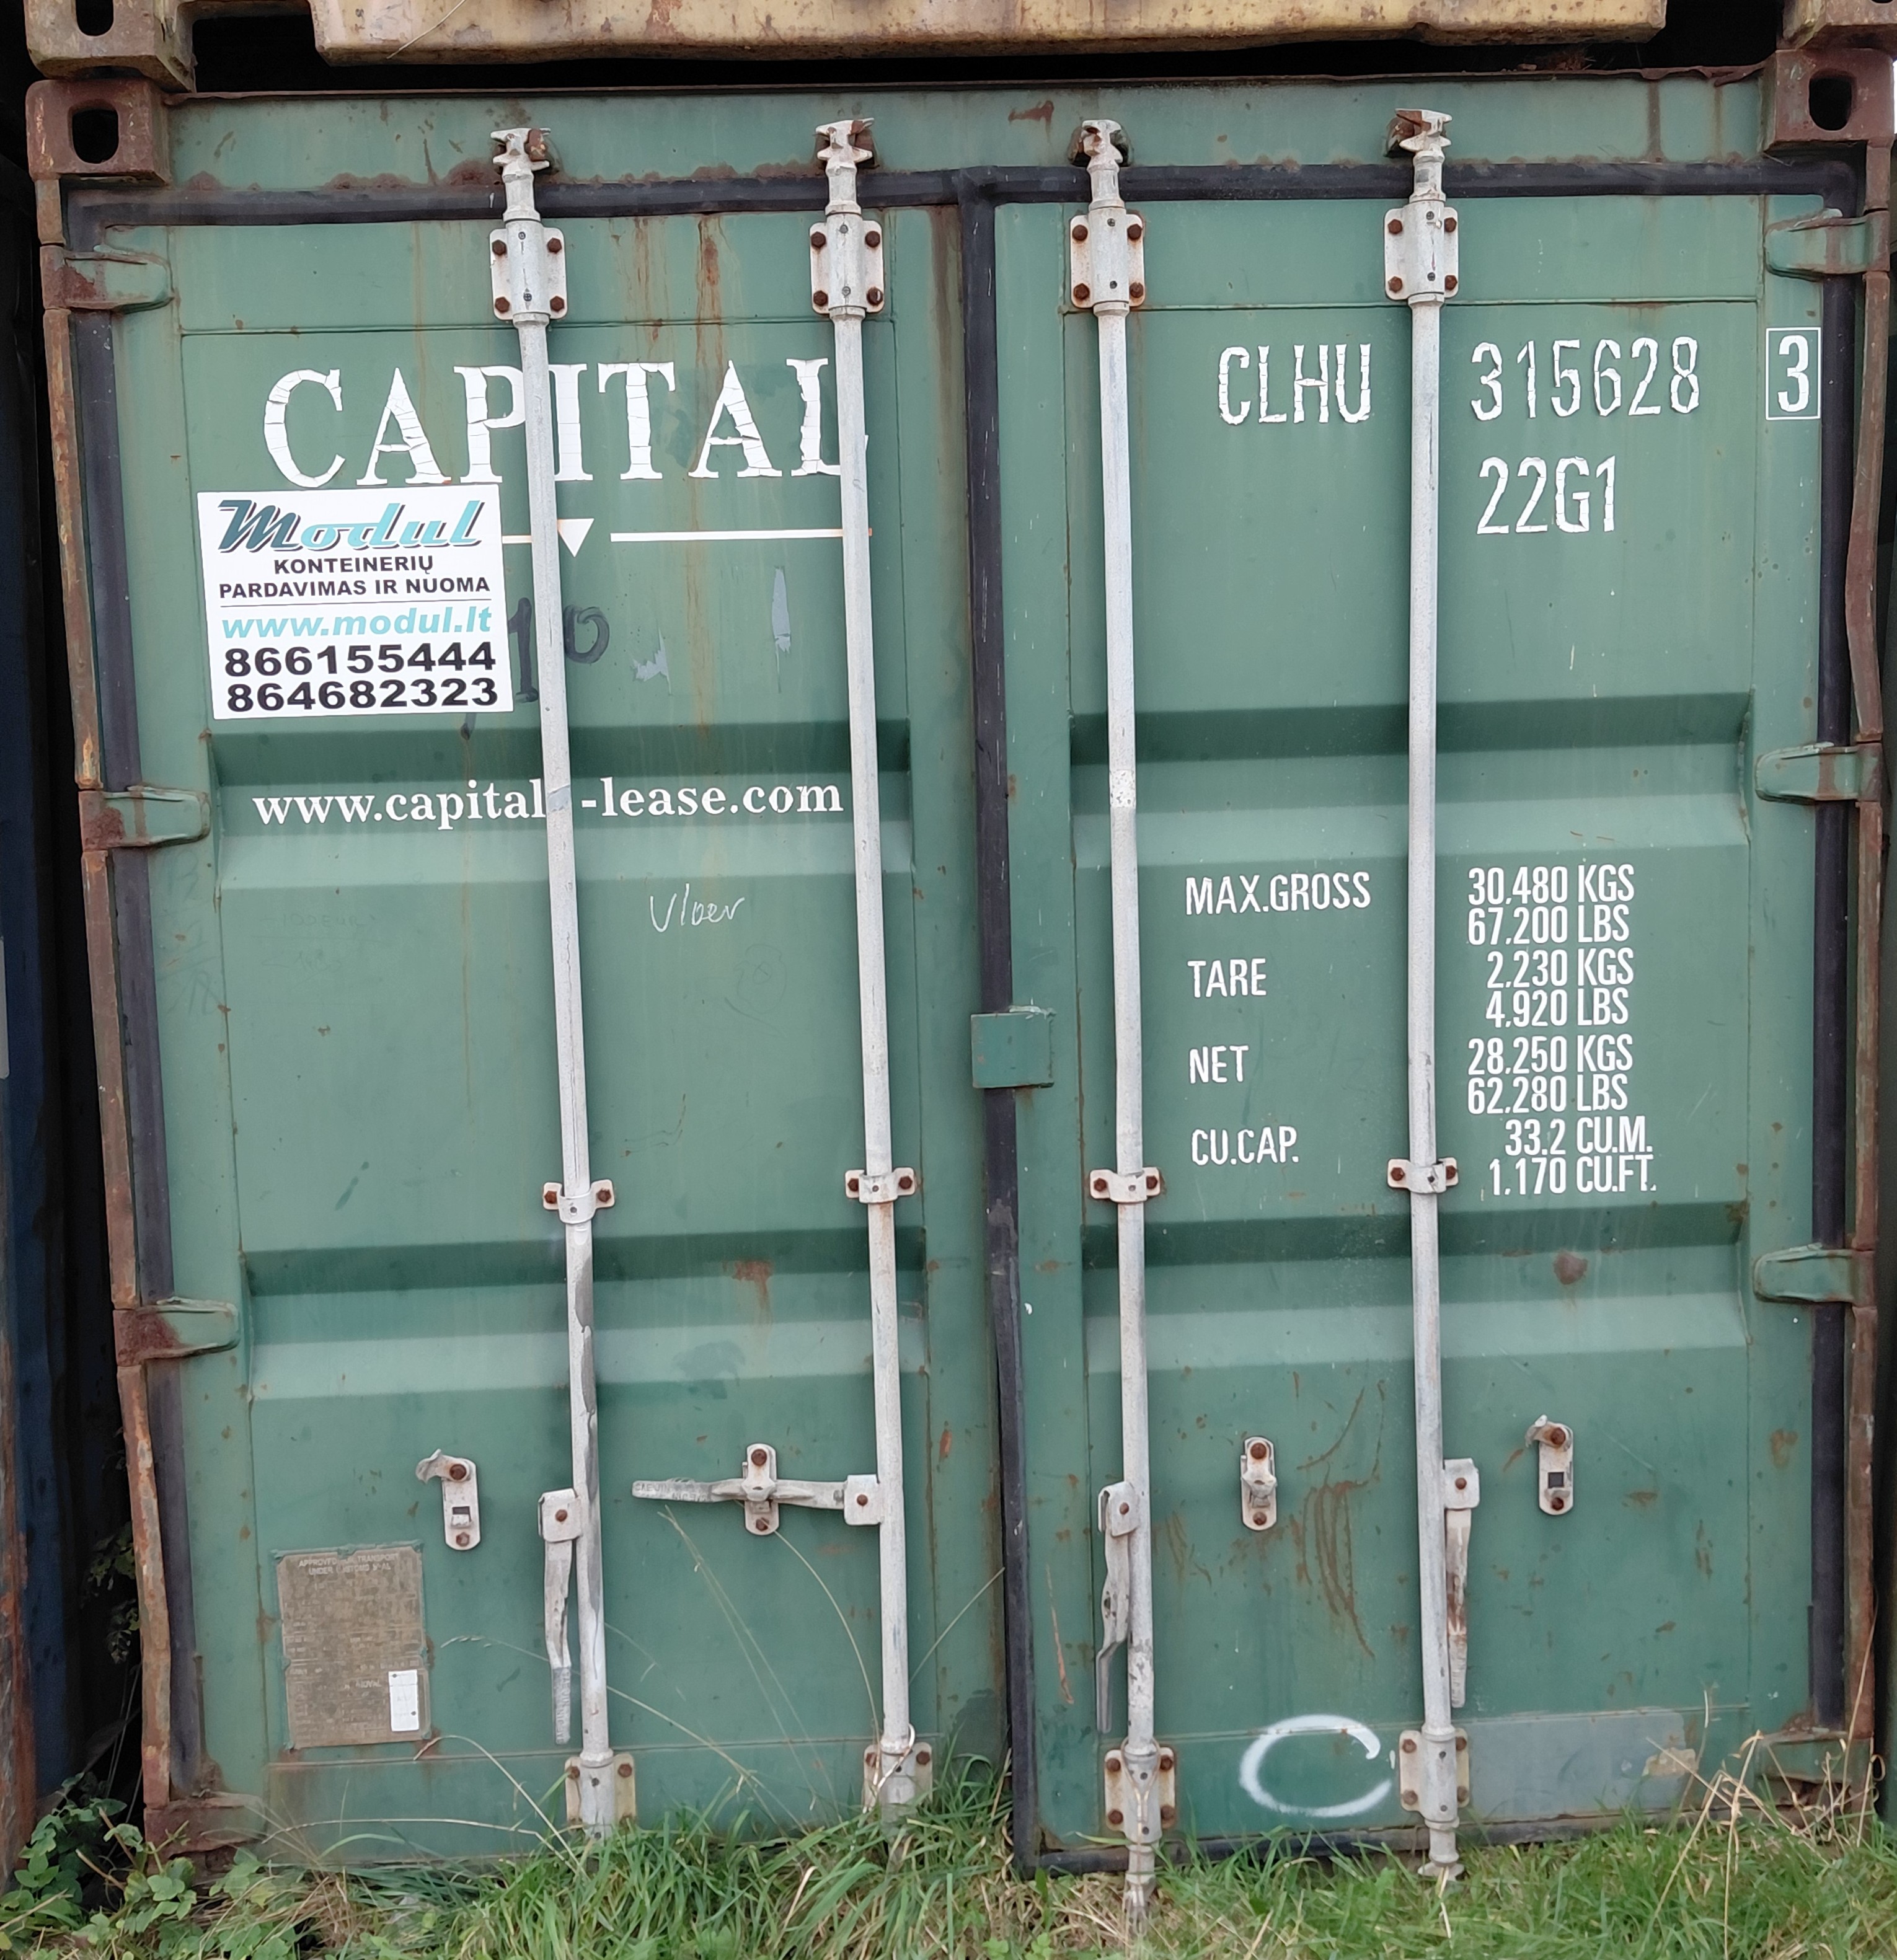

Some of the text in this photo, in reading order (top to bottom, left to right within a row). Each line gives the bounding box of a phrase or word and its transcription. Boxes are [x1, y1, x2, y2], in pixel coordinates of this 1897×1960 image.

[1219, 334, 1811, 425] CLHU 315628 3
[263, 358, 869, 488] CAPITAL
[1475, 454, 1616, 535] 22G1
[218, 499, 485, 553] Modul
[274, 555, 434, 575] KONTEINERIŲ
[219, 576, 491, 599] PARDAVIMAS IR NUOMA
[222, 606, 492, 638] www.modul.lt
[224, 641, 496, 678] 866155444
[227, 678, 498, 713] 864682323
[1185, 871, 1371, 916] MAX.GROSS
[1578, 864, 1635, 903] KGS
[1578, 904, 1630, 943] LBS
[1187, 958, 1267, 999] TARE
[1577, 947, 1634, 986] KGS
[1577, 987, 1629, 1026] LBS
[1189, 1044, 1250, 1084] NET
[1576, 1033, 1634, 1072] KGS
[1576, 1073, 1629, 1111] LBS
[1191, 1125, 1299, 1166] CU.CAP.
[1504, 1115, 1653, 1156] 33.2 CU.M.
[1576, 1154, 1657, 1193] CU.FT.
